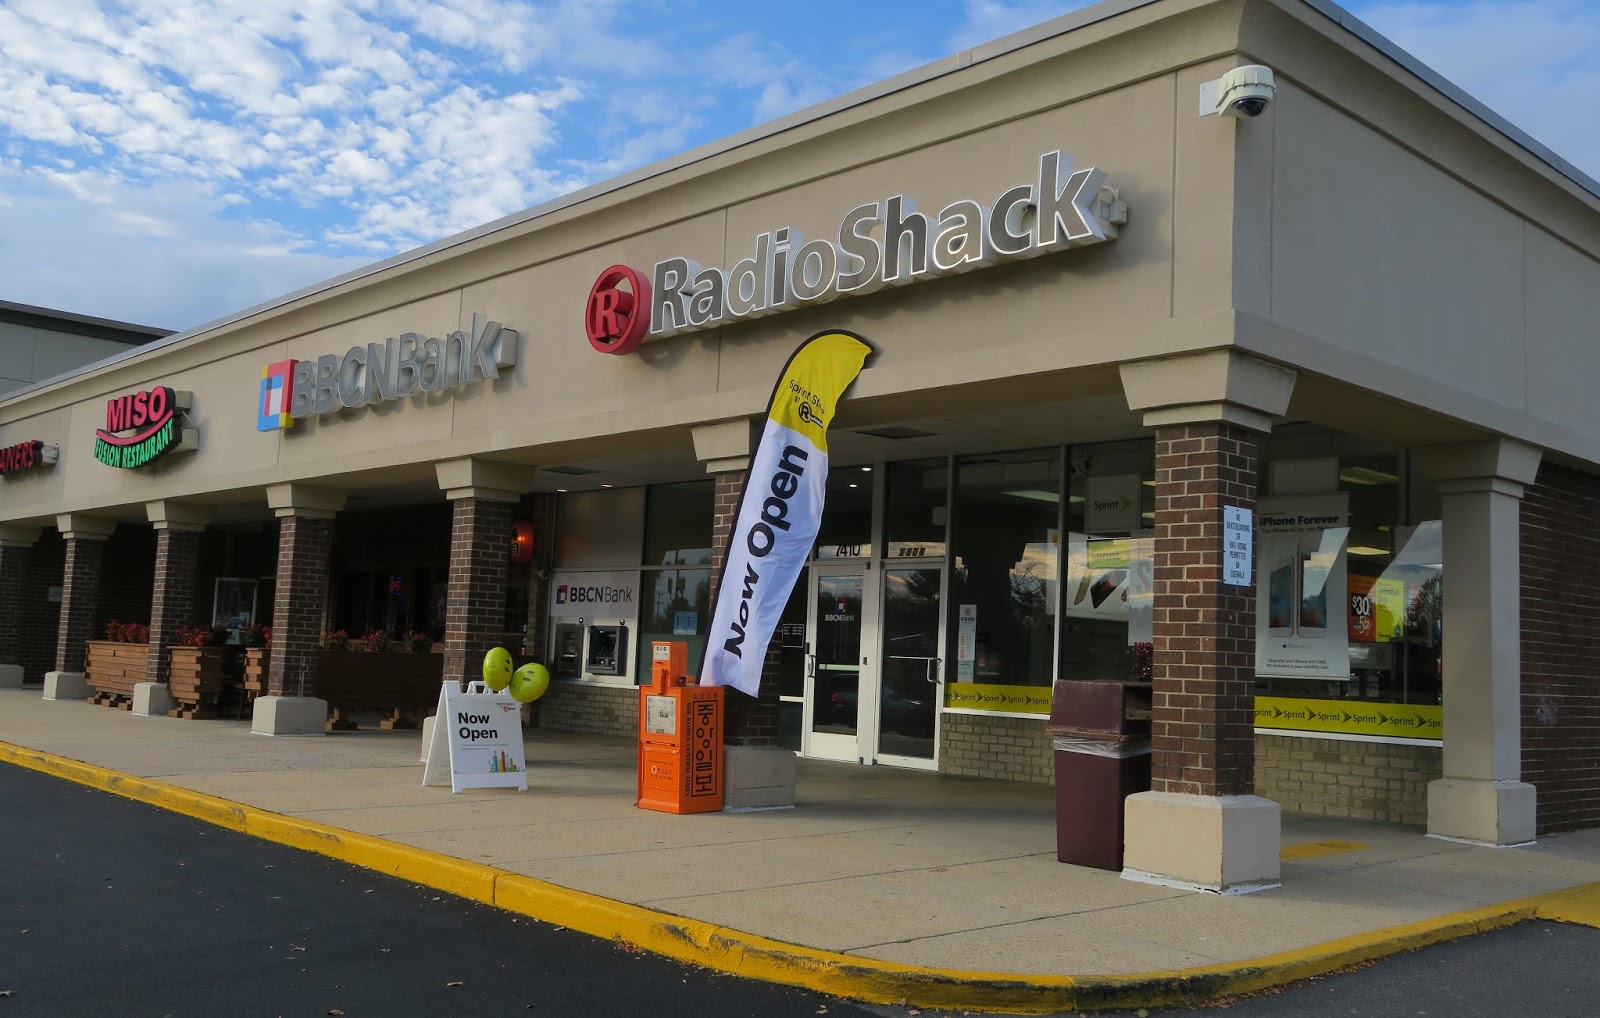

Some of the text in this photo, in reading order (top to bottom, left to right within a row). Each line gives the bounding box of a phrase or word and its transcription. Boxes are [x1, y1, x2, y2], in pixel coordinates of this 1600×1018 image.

[650, 149, 1098, 335] RadioShack
[790, 379, 811, 400] Sprint
[107, 386, 166, 432] MISO
[94, 417, 173, 468] FUSION RESTAURANT
[1094, 500, 1119, 512] Sprint
[1259, 516, 1339, 526] iPhone Forever
[723, 445, 809, 660] Now Open
[836, 544, 861, 556] 7410
[1091, 551, 1120, 563] Sprint
[960, 693, 976, 701] Sprint
[984, 694, 1000, 702] Sprint
[1008, 696, 1024, 704] Sprint
[1032, 697, 1049, 705] Sprint
[458, 712, 490, 724] Now
[1254, 708, 1443, 729] print Sprint Sprint Sprint Sprint Spri
[459, 727, 498, 741] Open
